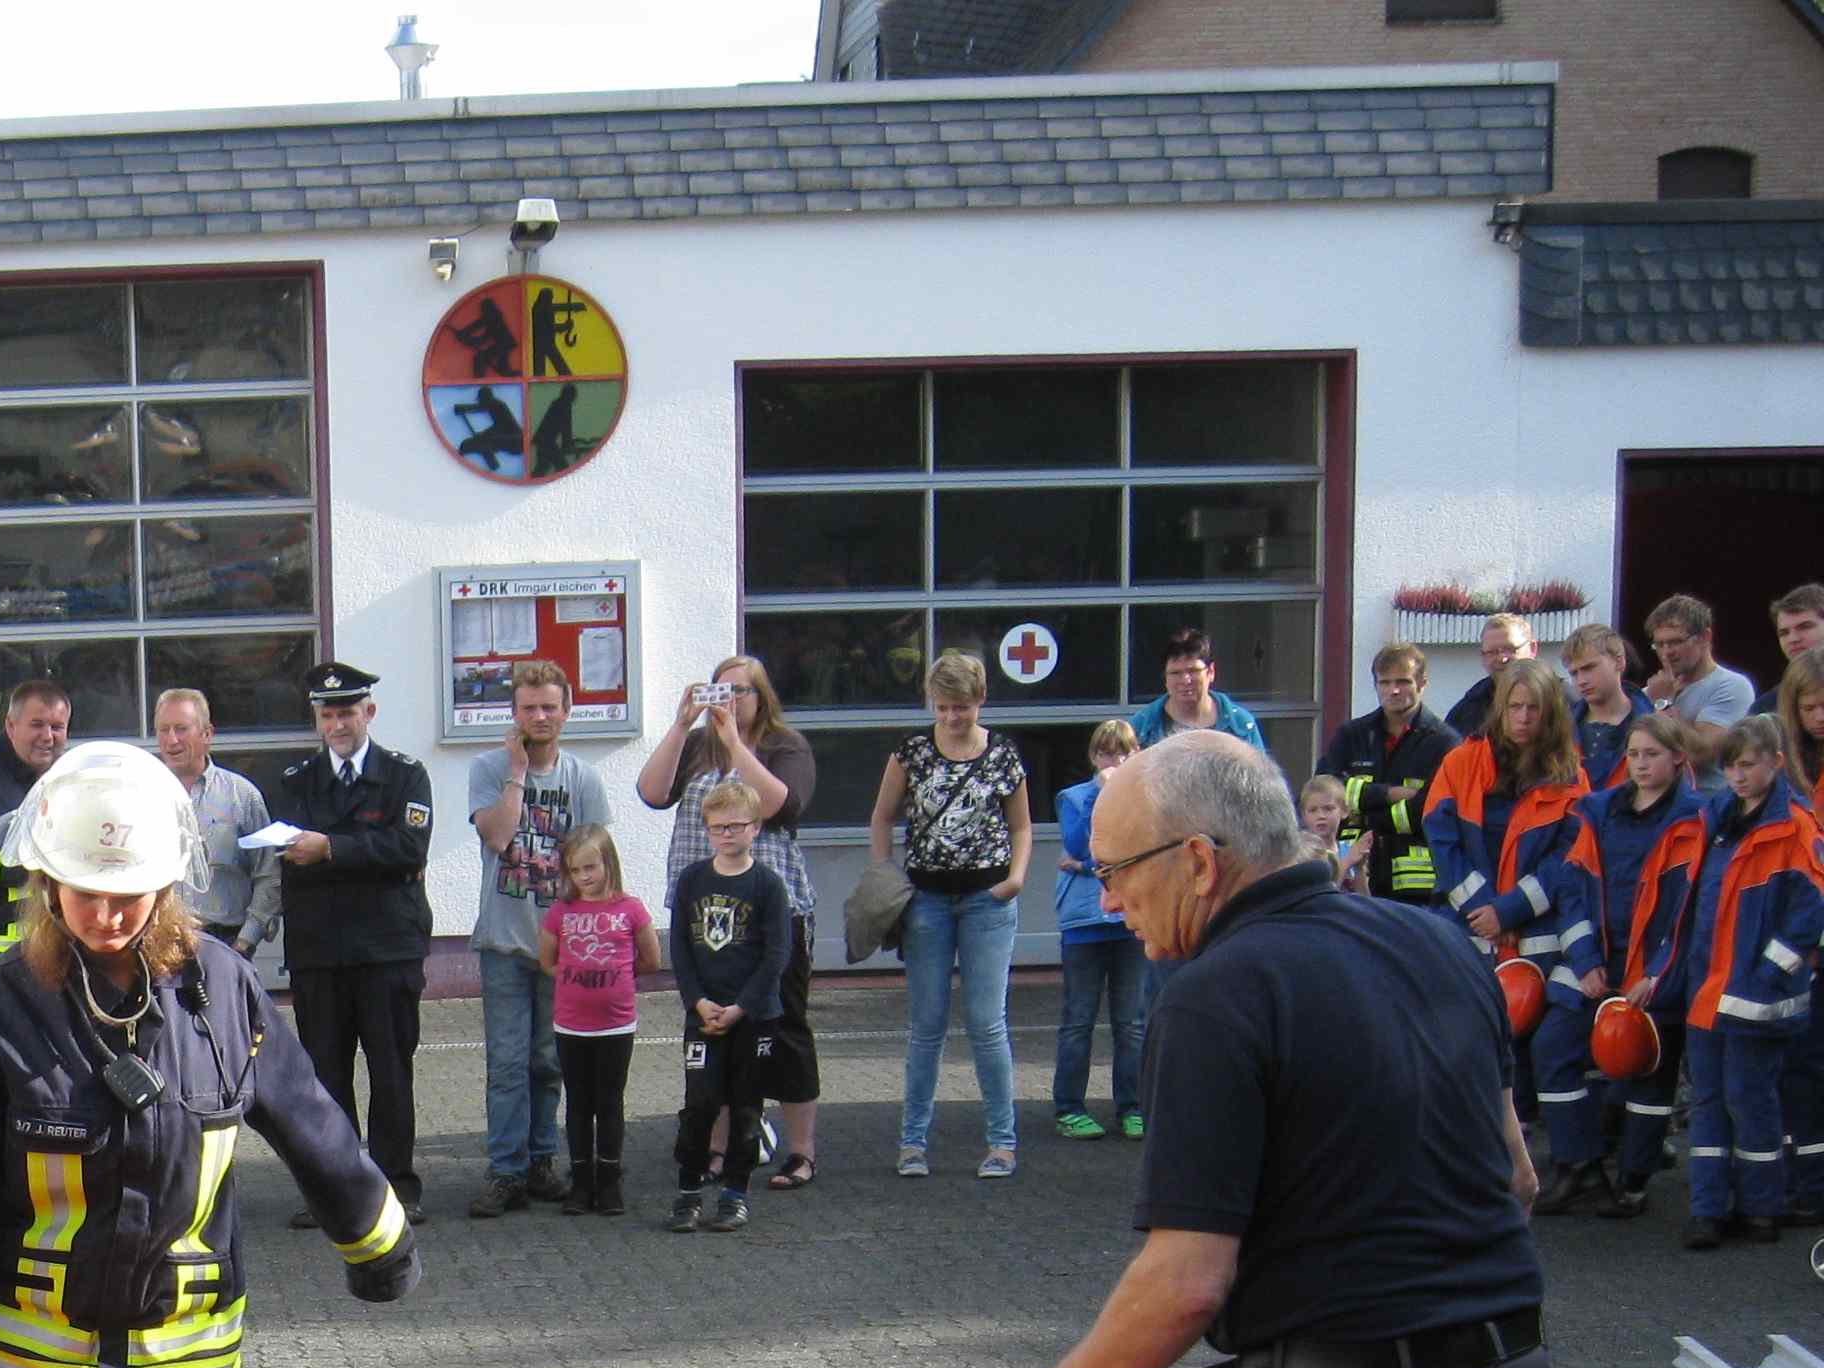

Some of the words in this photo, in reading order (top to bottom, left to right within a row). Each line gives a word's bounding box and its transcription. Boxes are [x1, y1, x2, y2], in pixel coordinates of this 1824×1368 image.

[479, 581, 508, 596] DRK
[514, 582, 597, 596] Irmgarteichen
[476, 712, 513, 722] Feuerw
[562, 912, 630, 935] ROCK
[48, 1125, 88, 1139] REUTER
